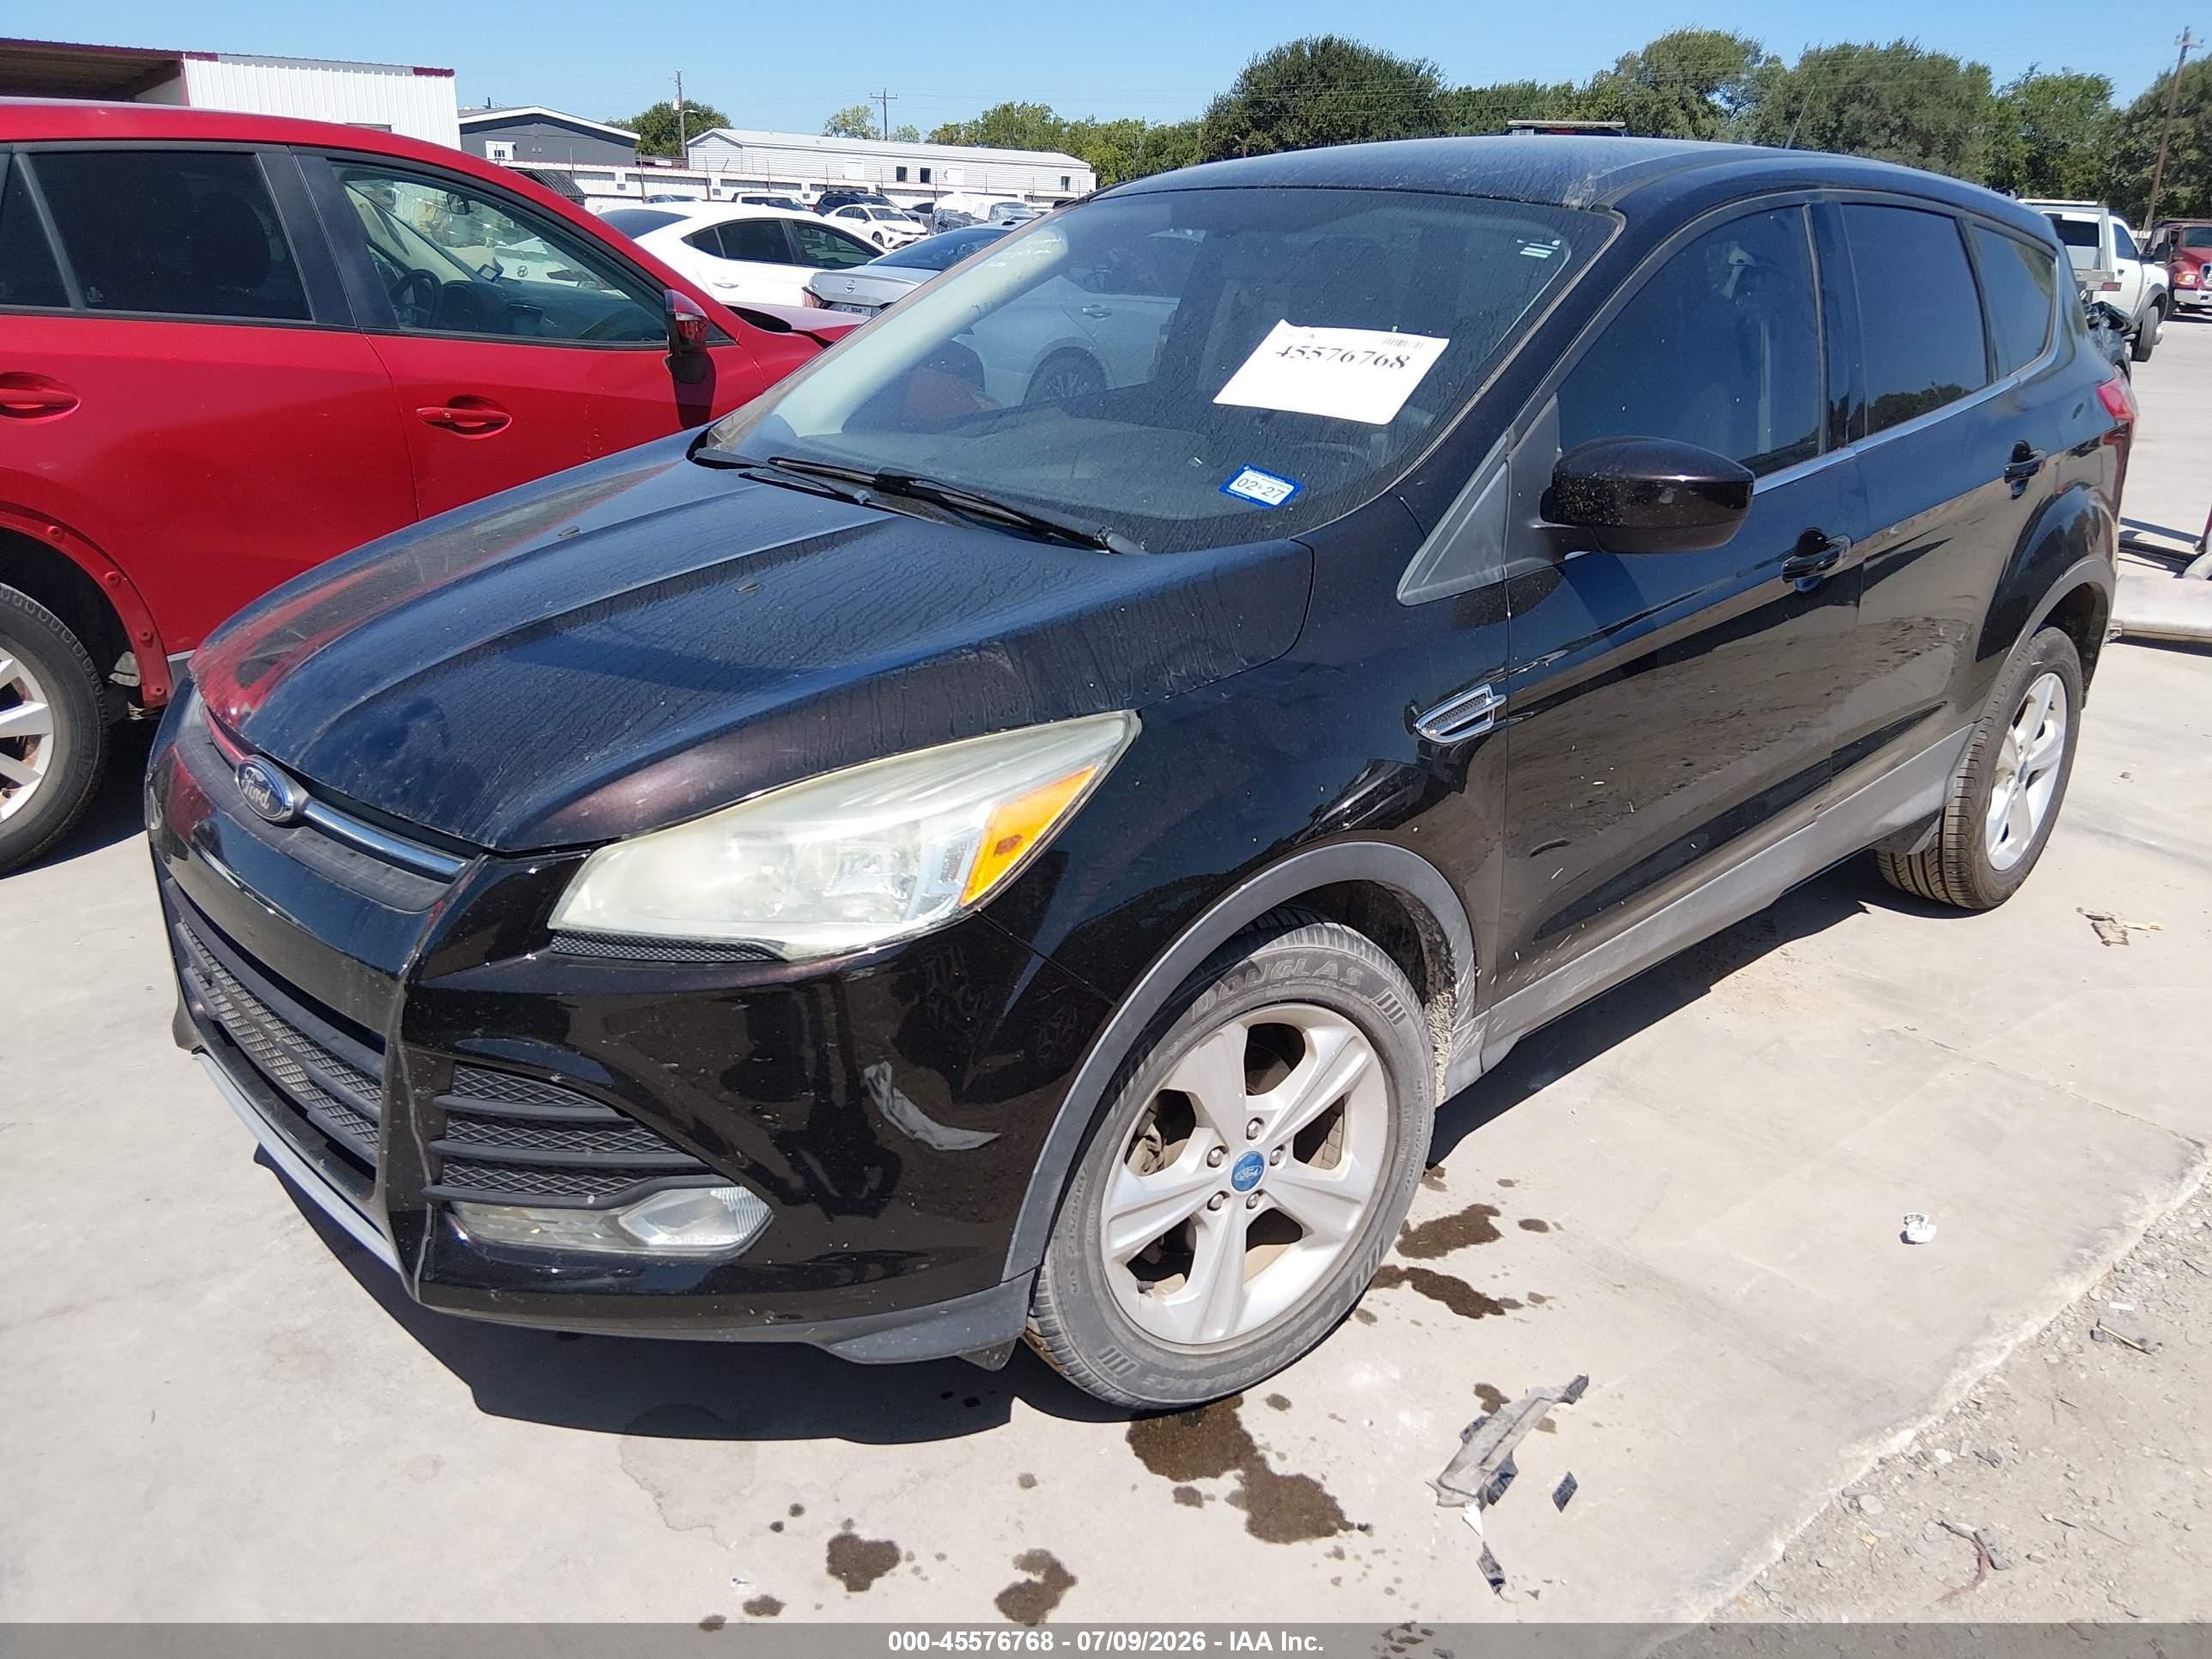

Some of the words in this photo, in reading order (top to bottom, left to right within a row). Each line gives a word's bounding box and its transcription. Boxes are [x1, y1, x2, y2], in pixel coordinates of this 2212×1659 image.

[1276, 344, 1410, 369] 45576768
[240, 766, 271, 810] Ford
[1192, 957, 1364, 1022] DOUGLAS
